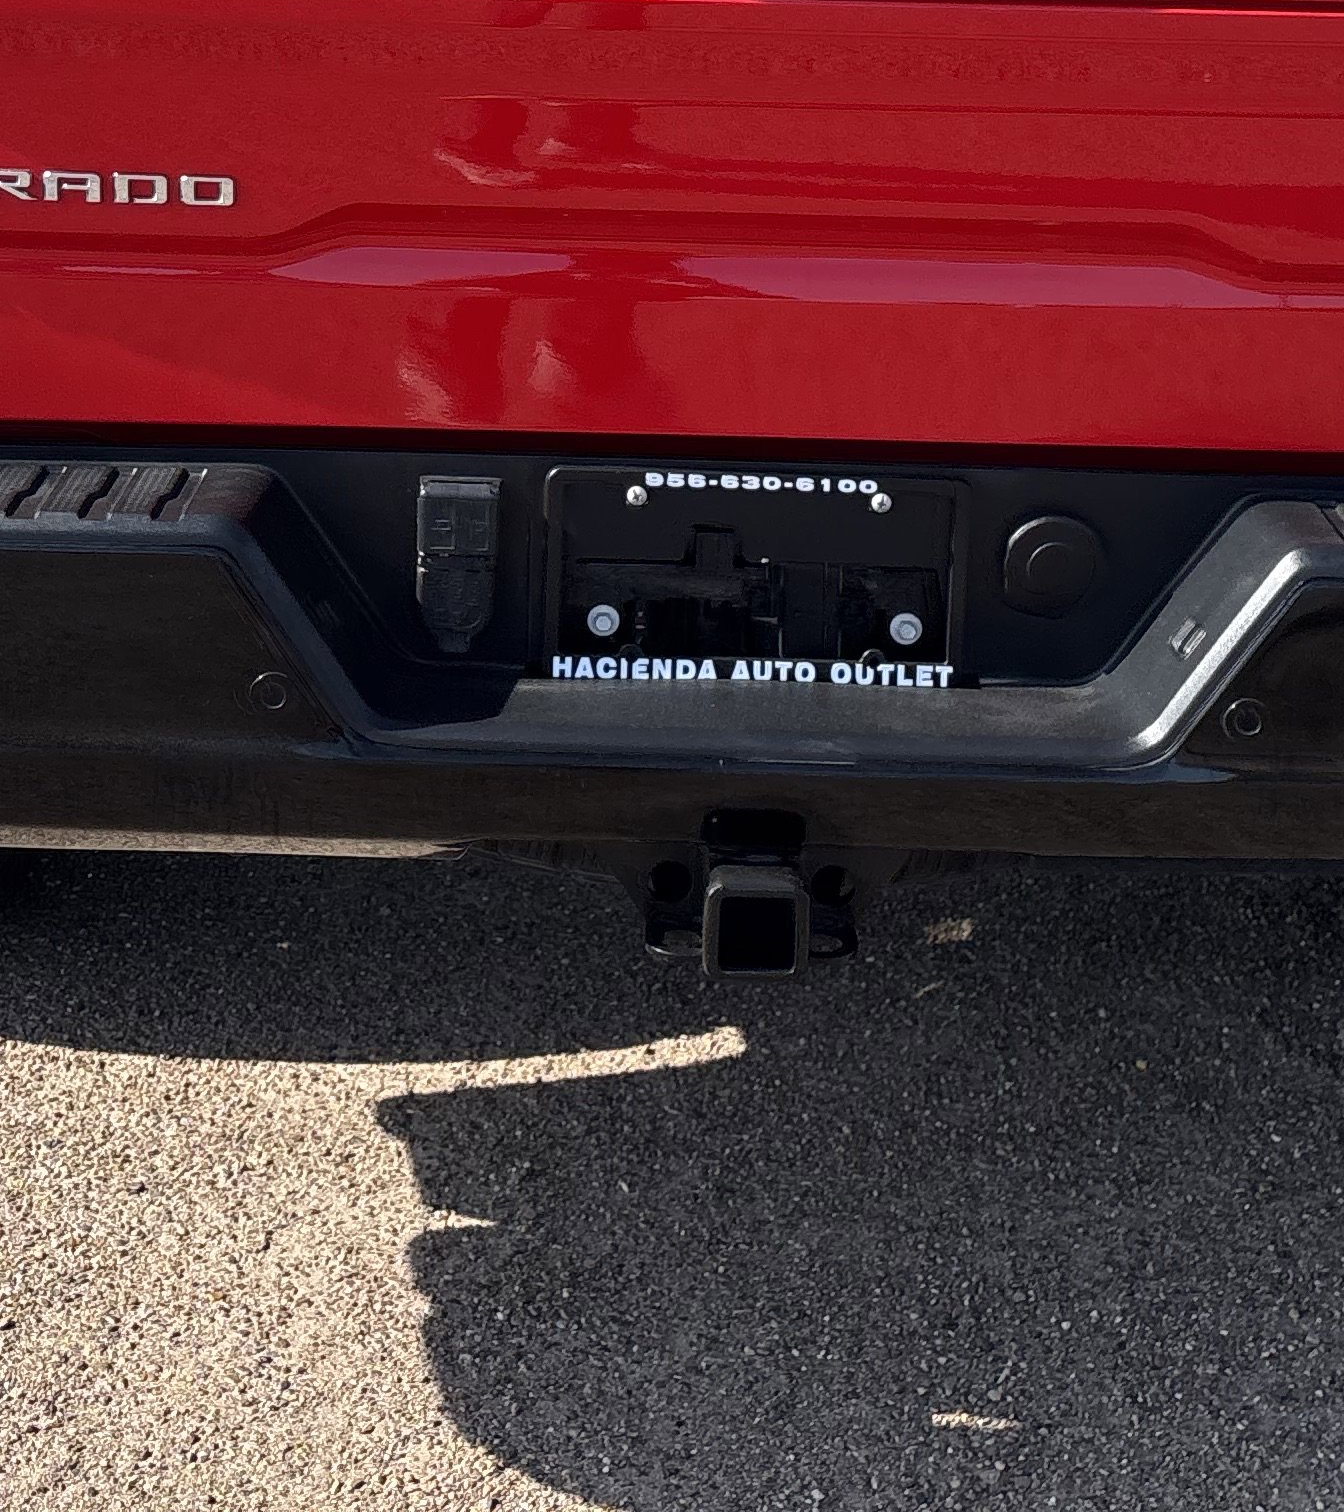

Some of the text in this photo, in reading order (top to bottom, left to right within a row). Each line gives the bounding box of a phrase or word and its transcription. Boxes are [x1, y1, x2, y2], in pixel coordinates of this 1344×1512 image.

[552, 656, 954, 688] HACIENDA AUTO OUTLET
